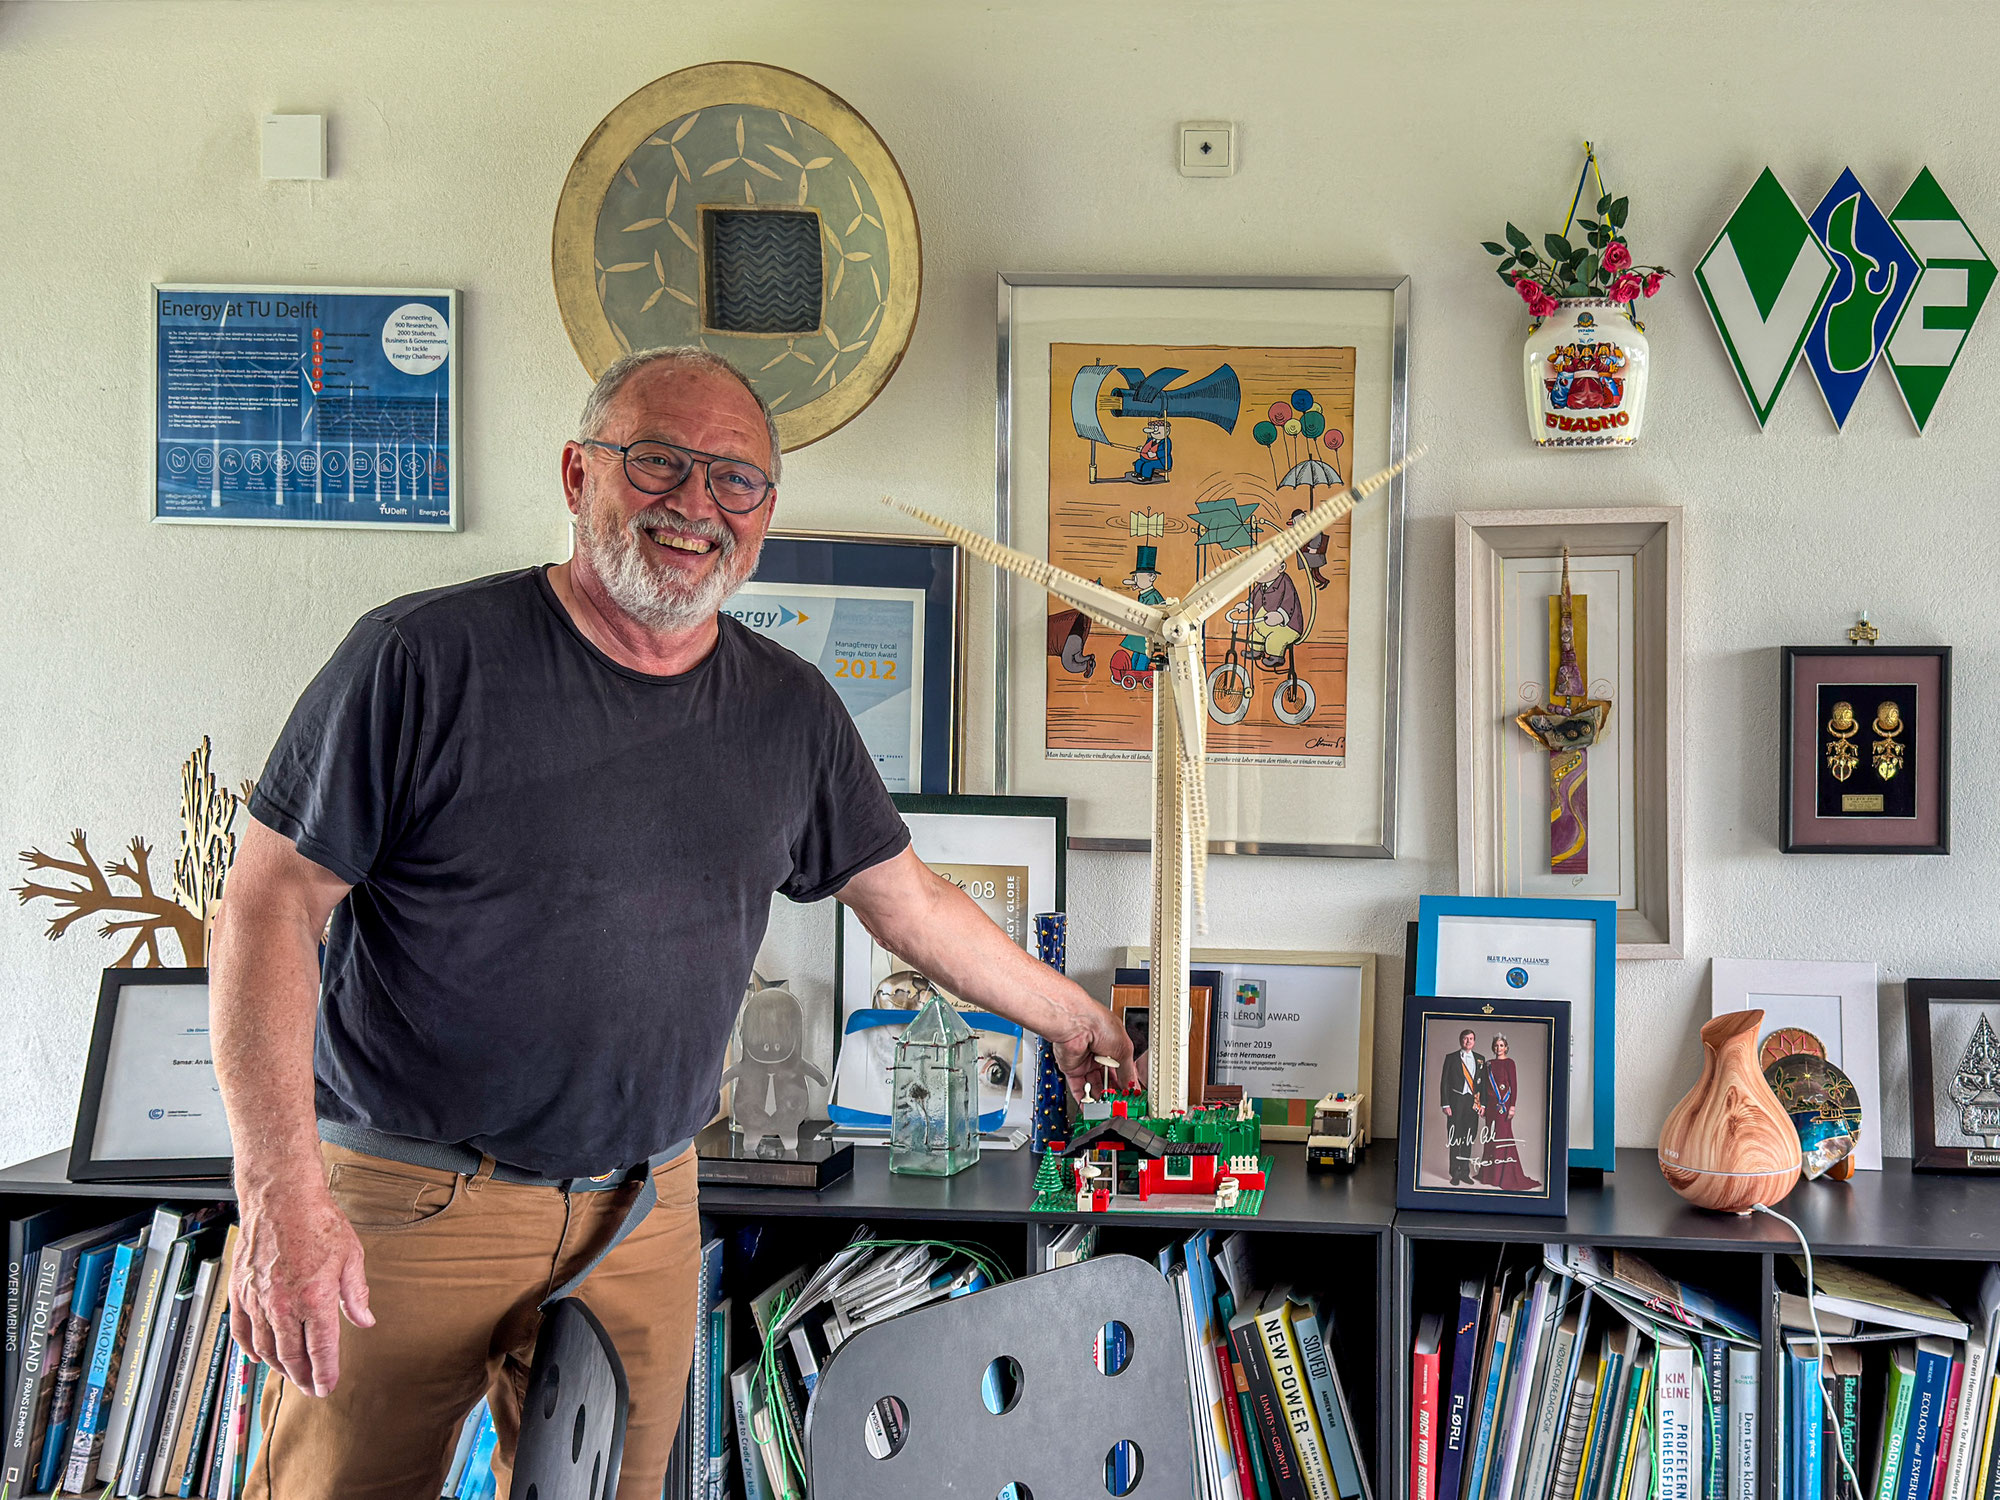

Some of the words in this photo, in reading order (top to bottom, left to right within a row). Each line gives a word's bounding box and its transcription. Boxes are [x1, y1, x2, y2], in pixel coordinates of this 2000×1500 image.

[162, 300, 222, 320] Energy
[227, 303, 243, 317] at
[247, 301, 270, 318] TU
[276, 301, 318, 318] Delft
[1545, 411, 1629, 433] БУДЬМО
[419, 509, 438, 517] Energy
[835, 641, 878, 650] ManagEnergy
[835, 658, 897, 680] 2012
[971, 881, 995, 899] 08
[1233, 1010, 1263, 1020] LÉRON
[1267, 1013, 1300, 1021] AWARD
[1224, 1040, 1252, 1048] Winner
[1254, 1041, 1272, 1049] 2019
[6, 1261, 19, 1295] OVER
[36, 1260, 56, 1299] STILL
[4, 1298, 18, 1352] LIMBURG
[23, 1299, 49, 1373] HOLLAND
[91, 1302, 119, 1374] POMORZE
[137, 1323, 146, 1338] Det
[214, 1322, 227, 1351] Pomerania
[129, 1347, 141, 1369] Thott
[208, 1365, 216, 1377] and
[211, 1351, 220, 1366] West
[1301, 1334, 1328, 1381] SOLVED!
[1713, 1348, 1722, 1367] THE
[1969, 1353, 1981, 1377] Søren
[123, 1369, 136, 1395] Palais
[1263, 1318, 1289, 1361] NEW
[1276, 1364, 1310, 1435] POWER
[1541, 1342, 1567, 1434] HØJSKOLEPÆDAGOGIK
[1665, 1373, 1685, 1384] KIM
[1713, 1369, 1722, 1402] WATER
[20, 1376, 34, 1407] FRANS
[121, 1396, 129, 1407] Le
[199, 1377, 215, 1413] Mecklenburg
[1320, 1389, 1333, 1413] ANDREW
[1661, 1387, 1690, 1400] LEINE
[1842, 1376, 1857, 1418] Radical
[1949, 1396, 1957, 1408] The
[1962, 1377, 1977, 1420] Hermansen
[81, 1386, 99, 1429] Pomerania
[735, 1399, 746, 1425] Cradle
[1258, 1393, 1276, 1426] LIMITS
[1326, 1412, 1337, 1428] WEAR
[1915, 1391, 1932, 1443] ECOLOGY
[12, 1405, 29, 1448] LEMMENS
[739, 1427, 746, 1436] to
[1269, 1426, 1277, 1436] TO
[1418, 1408, 1429, 1437] ROCK
[1447, 1394, 1465, 1450] FLØRLI
[1745, 1412, 1754, 1436] Den
[1959, 1427, 1968, 1440] Tor
[1270, 1435, 1291, 1480] GROWTH
[1417, 1438, 1428, 1465] YOUR
[1663, 1410, 1674, 1500] EVIGHEDSFJO
[1744, 1440, 1752, 1468] tavse
[1885, 1432, 1901, 1473] CRADLE
[1913, 1442, 1923, 1456] and
[1938, 1431, 1951, 1462] presume?
[744, 1467, 754, 1479] for
[1300, 1450, 1314, 1475] HENRY
[1307, 1476, 1321, 1500] TIMMS
[1305, 1437, 1321, 1467] JEREMY
[1313, 1467, 1331, 1500] HEIMANS
[1676, 1424, 1688, 1500] PROFETERN
[1950, 1441, 1967, 1495] Nørretranders
[1882, 1474, 1894, 1489] TO
